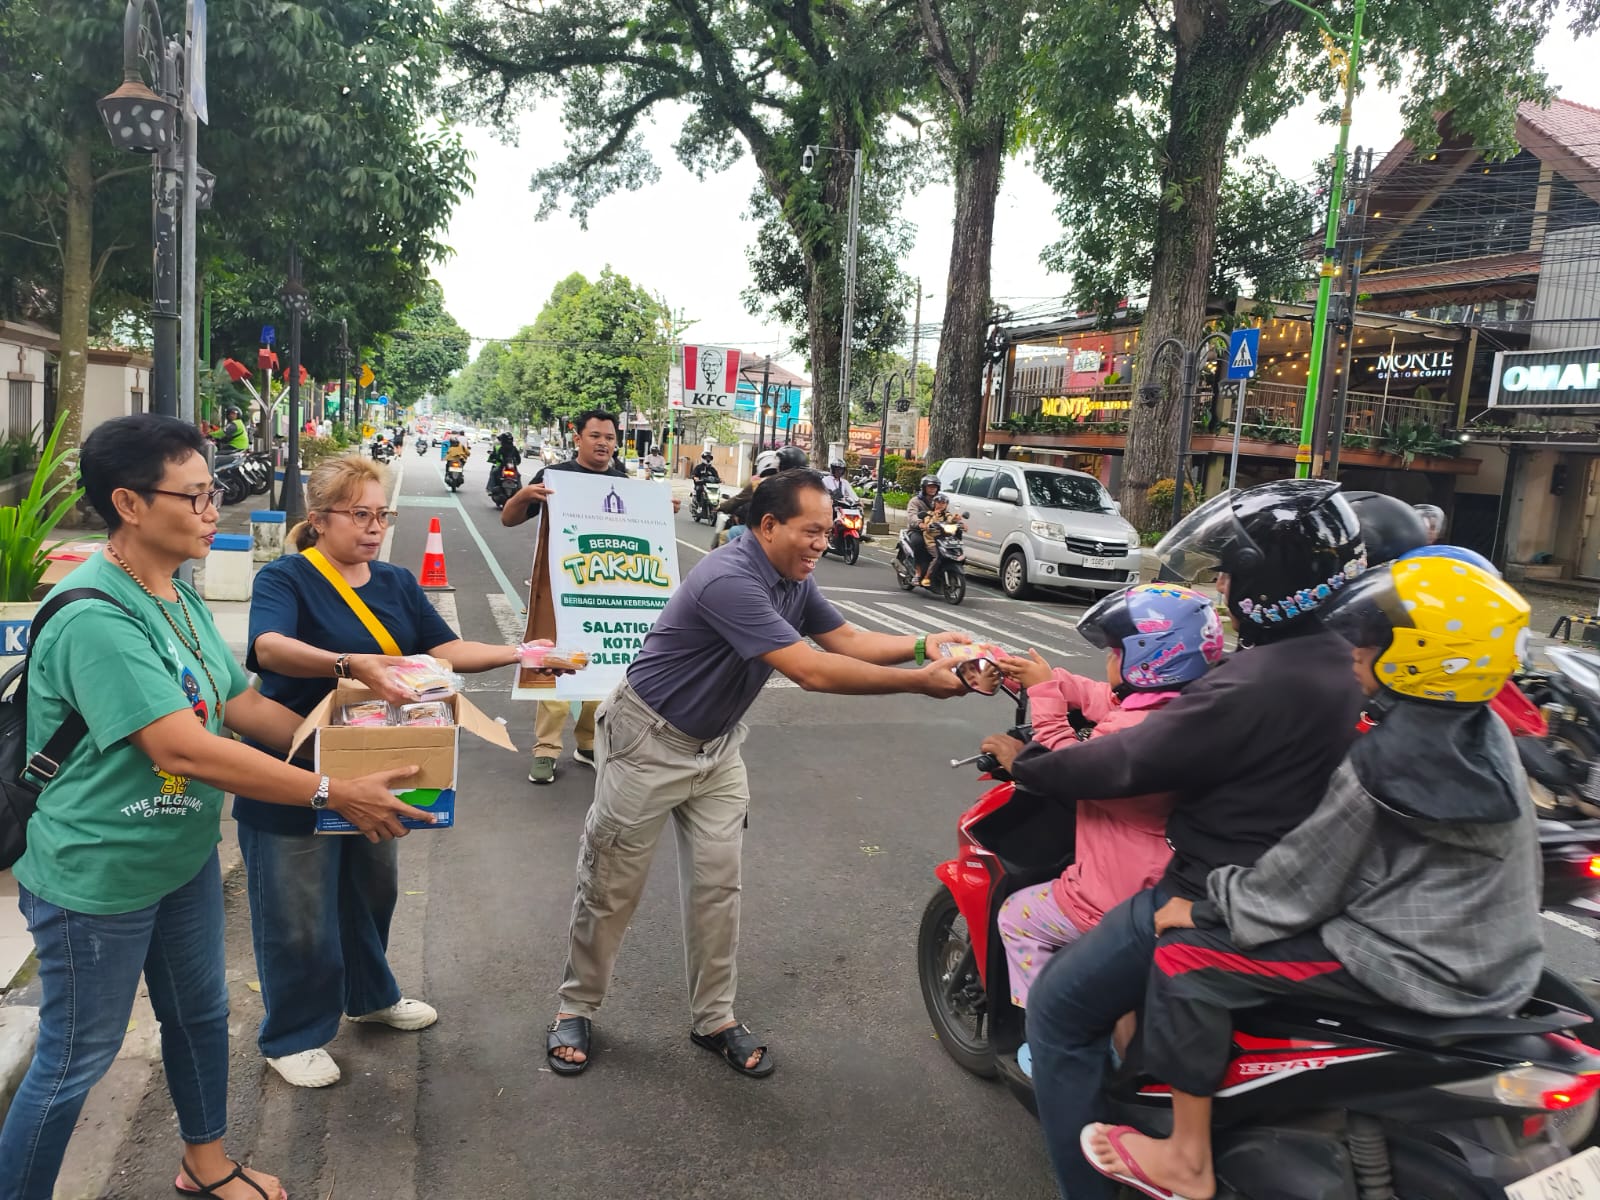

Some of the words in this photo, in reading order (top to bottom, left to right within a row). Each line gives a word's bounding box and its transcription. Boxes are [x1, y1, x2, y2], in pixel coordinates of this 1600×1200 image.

[1376, 352, 1454, 371] MONTE
[691, 393, 728, 407] KFC
[1041, 396, 1092, 419] MONTE
[589, 538, 639, 551] BERBAGI
[563, 552, 669, 586] TAKJIL
[563, 596, 595, 605] BERBAGI
[597, 598, 622, 606] DALAM
[624, 599, 669, 607] KEBERSAMA
[5, 626, 30, 651] K
[603, 637, 643, 648] KOTA
[591, 653, 640, 664] OLER
[121, 798, 151, 816] THE
[153, 794, 204, 812] PILGRIMS
[143, 807, 160, 818] OF
[161, 807, 187, 815] HOPE
